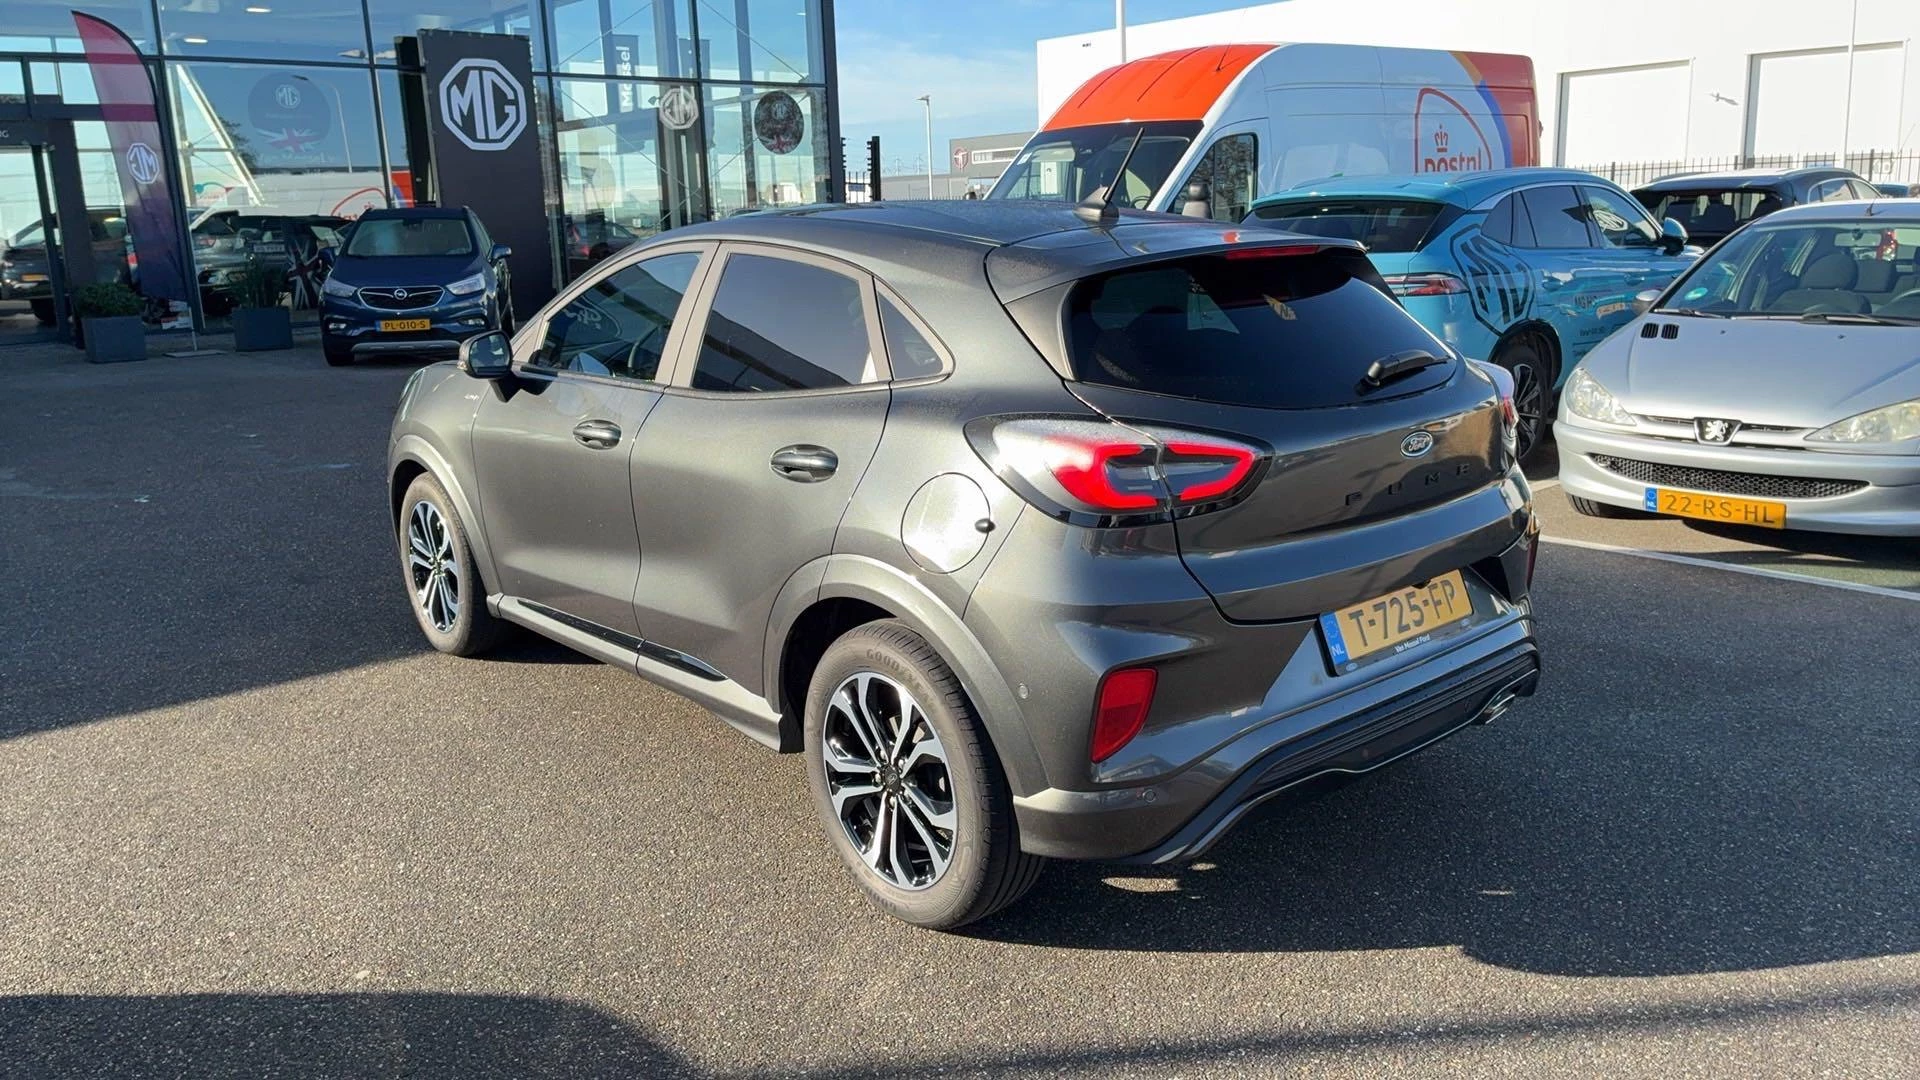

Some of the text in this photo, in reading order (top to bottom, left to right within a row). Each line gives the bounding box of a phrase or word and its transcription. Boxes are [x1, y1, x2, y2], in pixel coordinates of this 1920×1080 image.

[448, 69, 518, 141] MG
[1460, 235, 1531, 325] MG
[1408, 435, 1430, 452] Ford
[1664, 493, 1776, 524] 22-RS-HL
[1347, 579, 1455, 647] T-725-FP
[1330, 645, 1345, 656] NL
